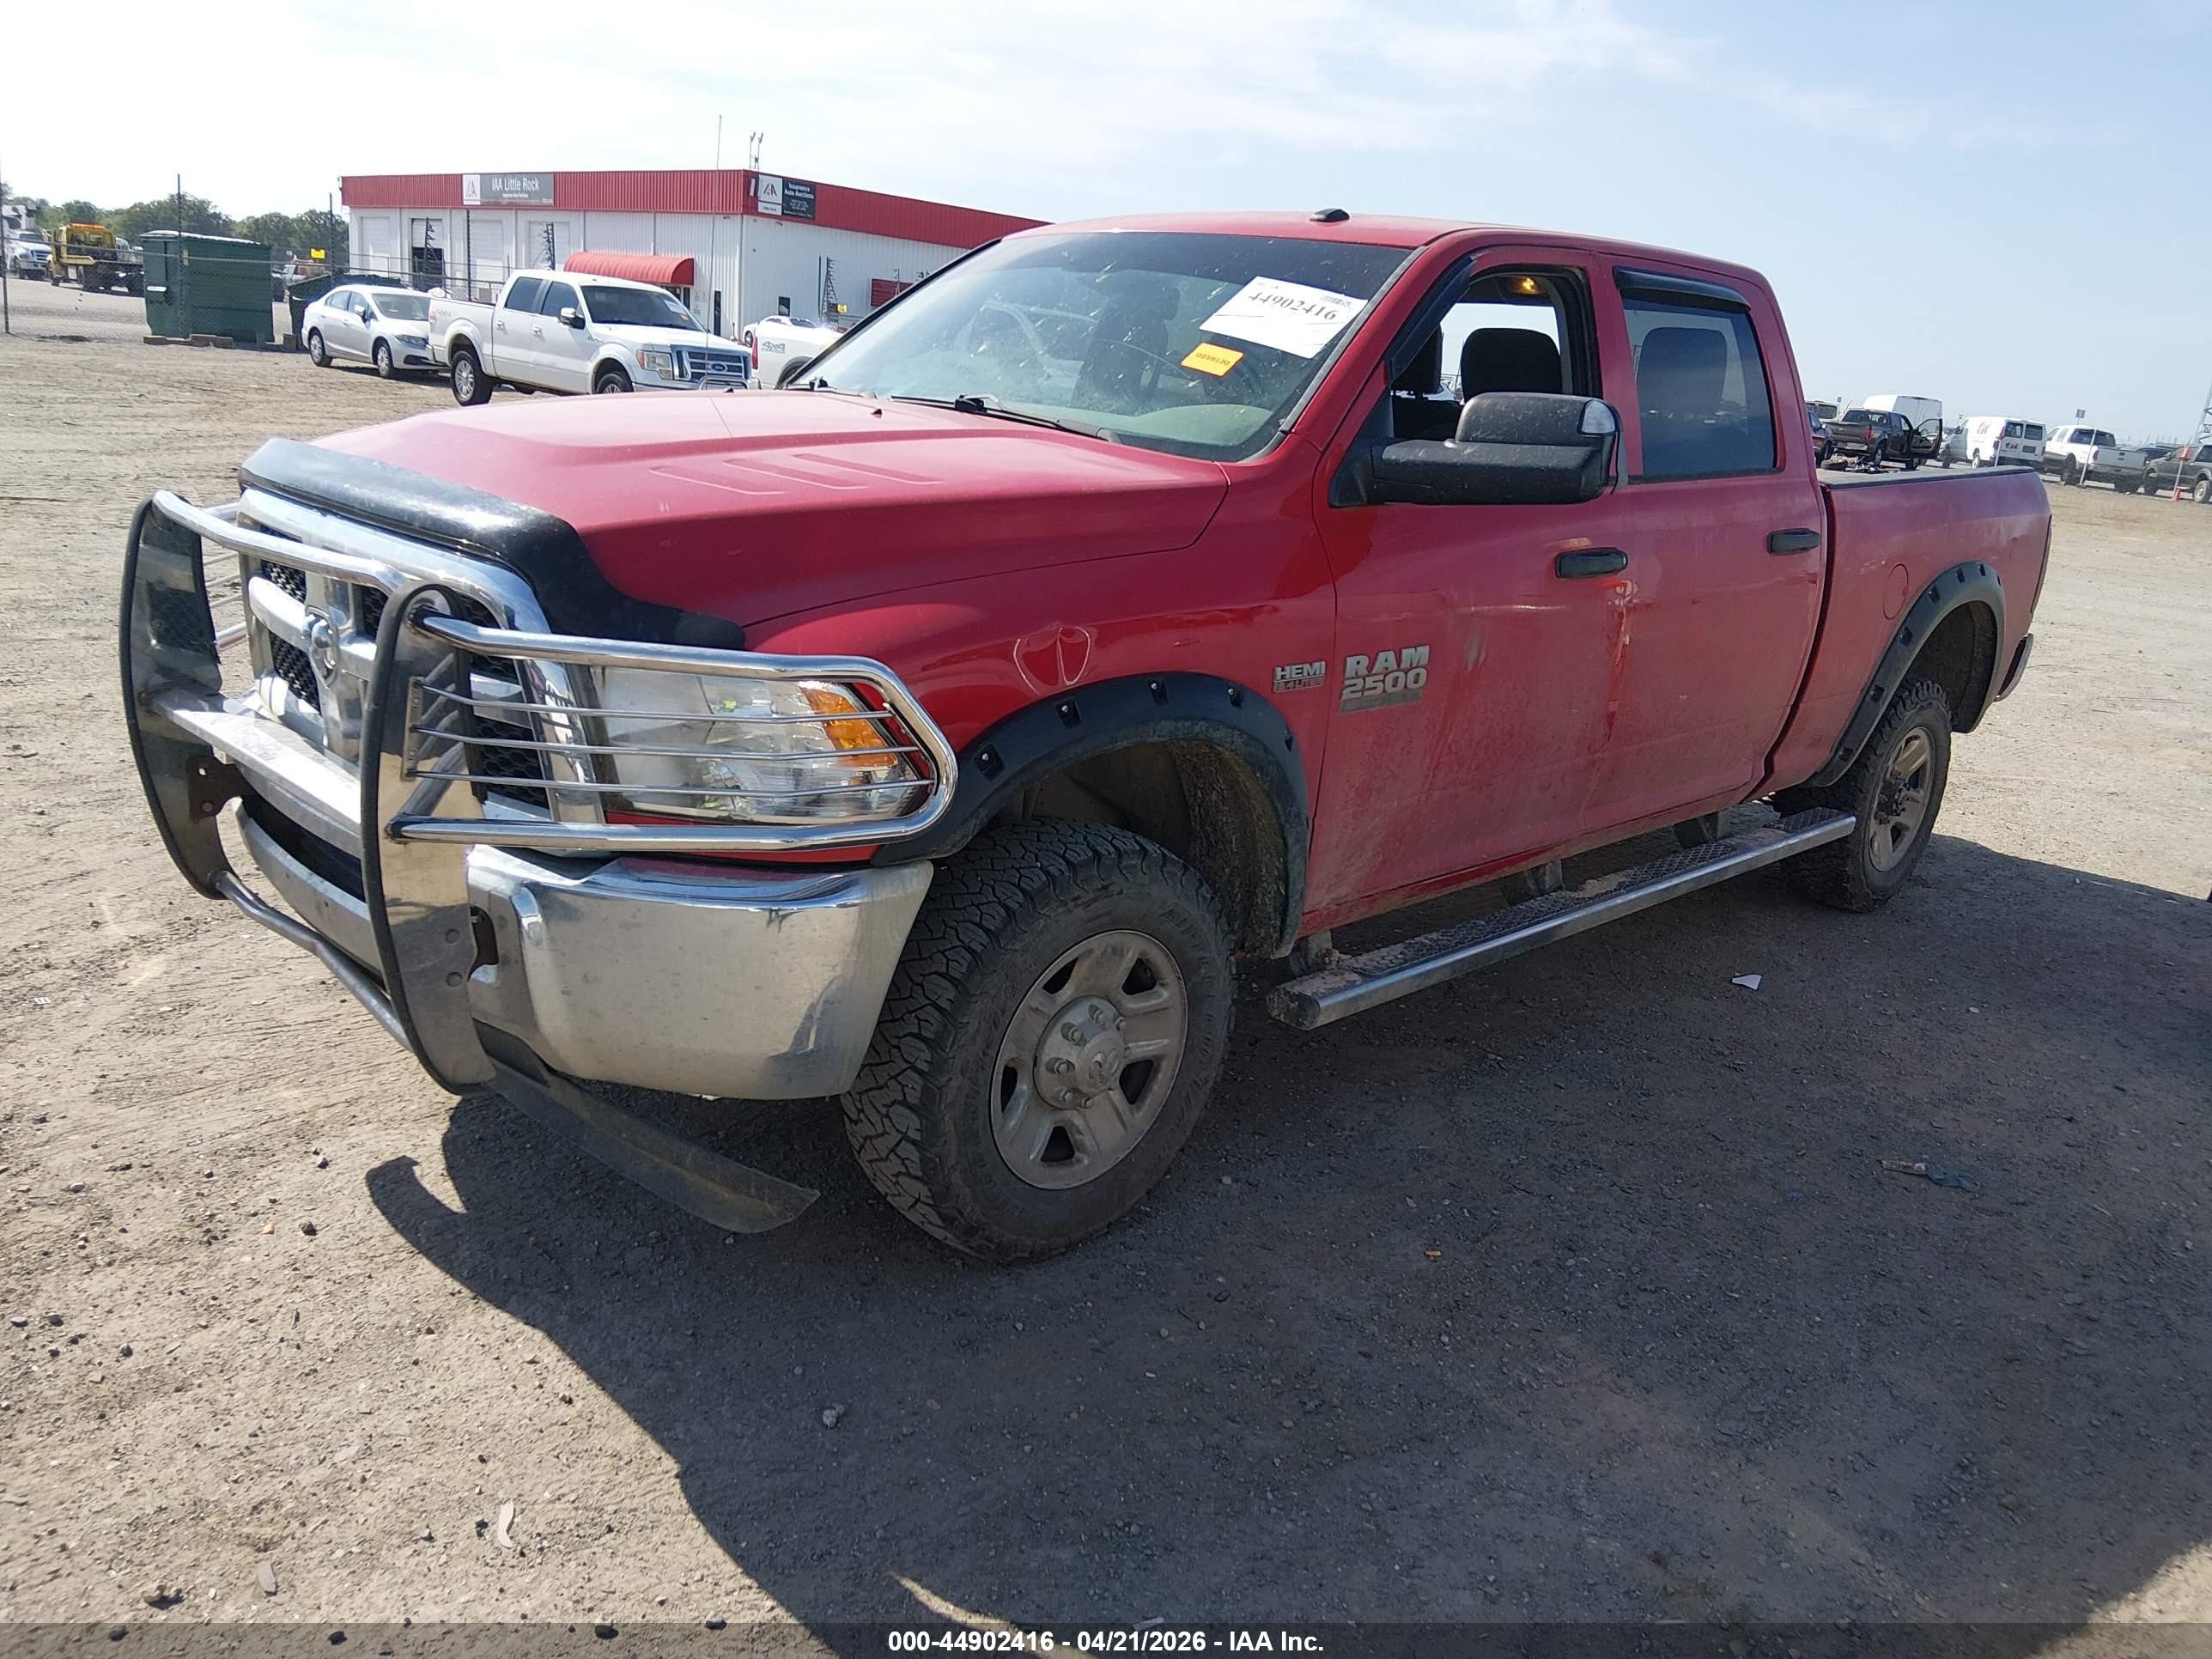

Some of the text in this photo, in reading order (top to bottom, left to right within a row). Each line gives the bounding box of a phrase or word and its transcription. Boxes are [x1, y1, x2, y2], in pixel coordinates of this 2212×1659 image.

[492, 177, 540, 192] IAA Little Rock
[1249, 292, 1340, 320] 44902416
[1195, 352, 1231, 367] DETAILED
[1274, 660, 1326, 681] HEMI
[1344, 645, 1430, 679] RAM
[1340, 667, 1427, 701] 2500
